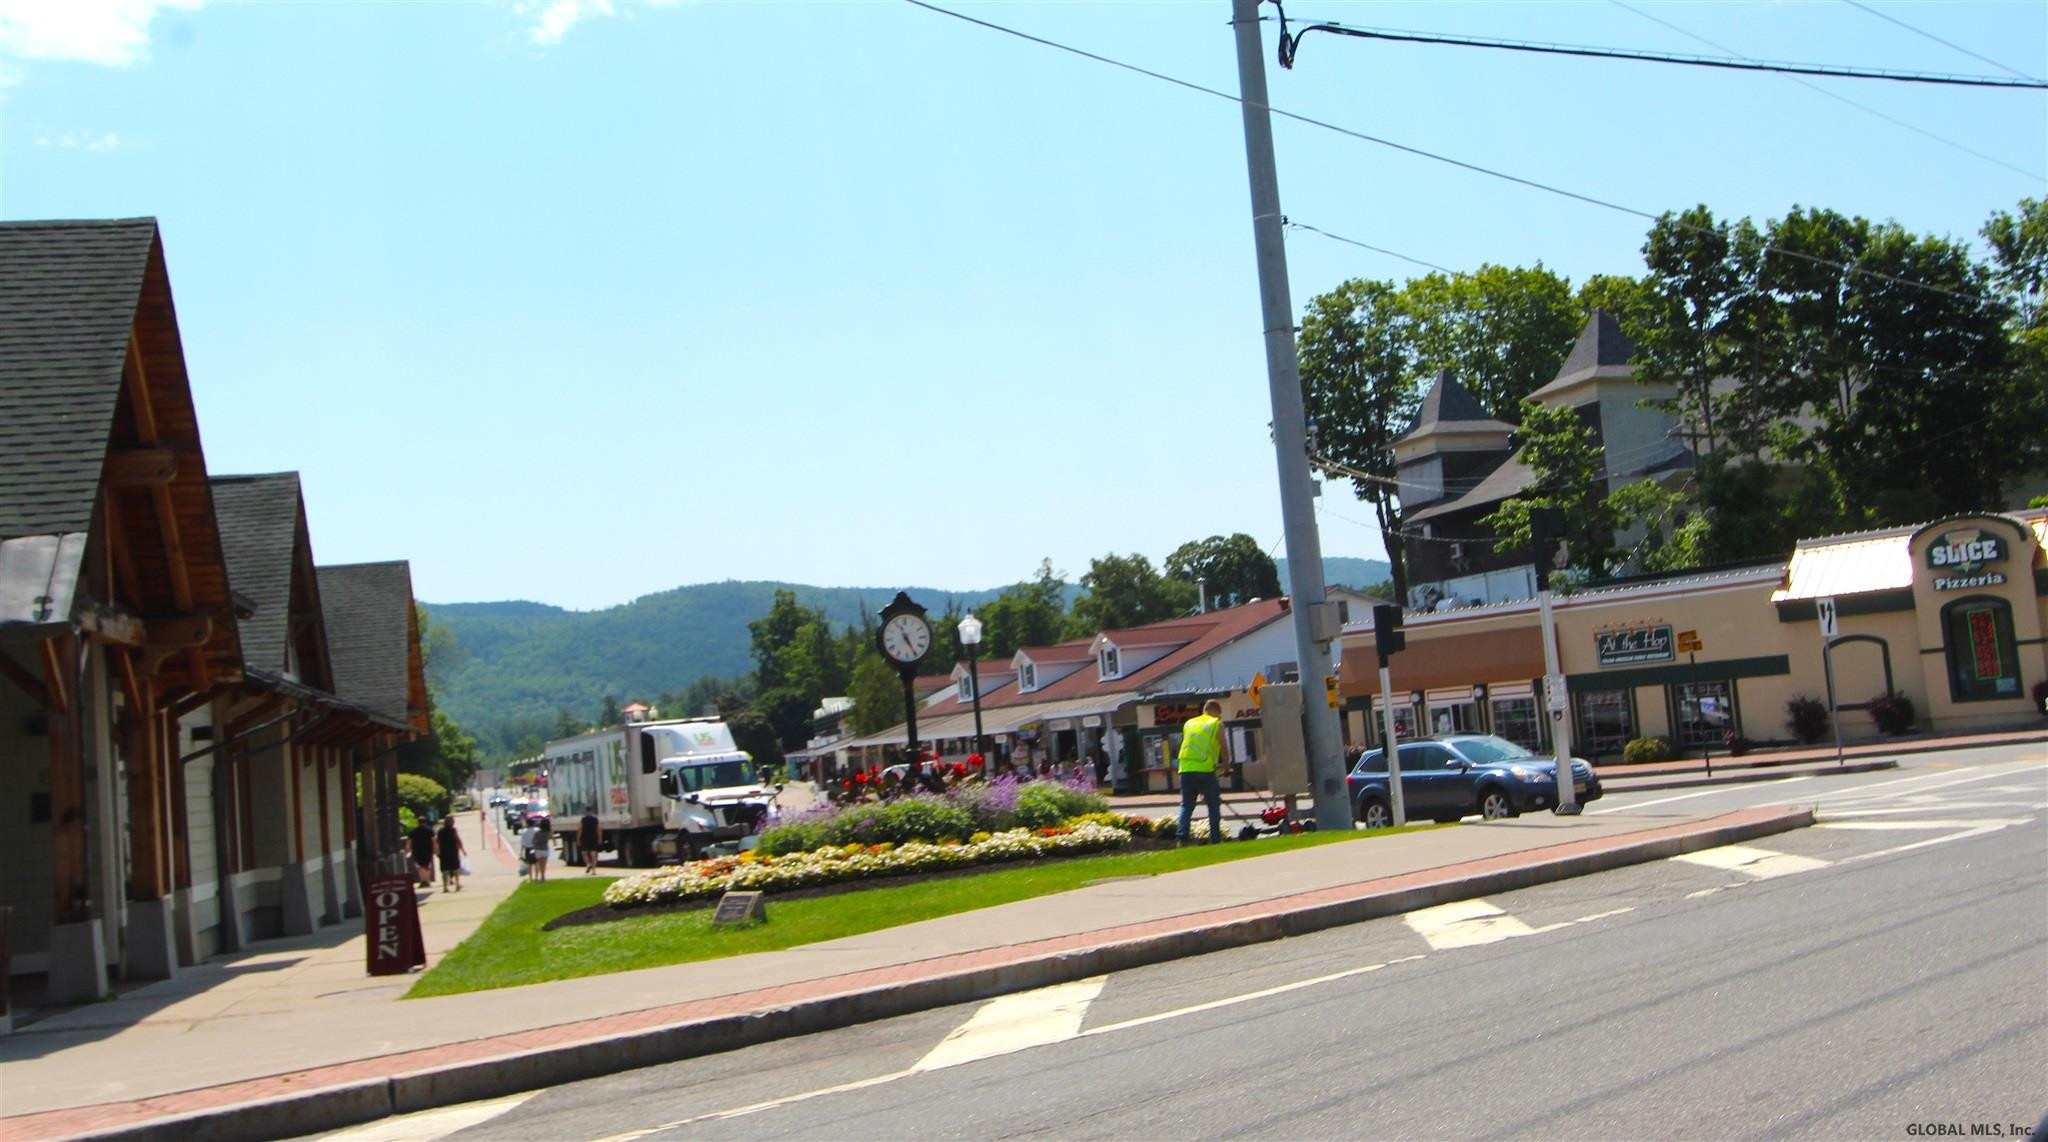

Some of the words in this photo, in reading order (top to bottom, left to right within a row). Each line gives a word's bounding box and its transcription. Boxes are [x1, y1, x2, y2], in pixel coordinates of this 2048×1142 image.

[1932, 540, 1998, 566] SLICE
[1935, 572, 2003, 590] Pizzeria
[1643, 628, 1668, 650] Hop
[375, 892, 400, 960] OPEN
